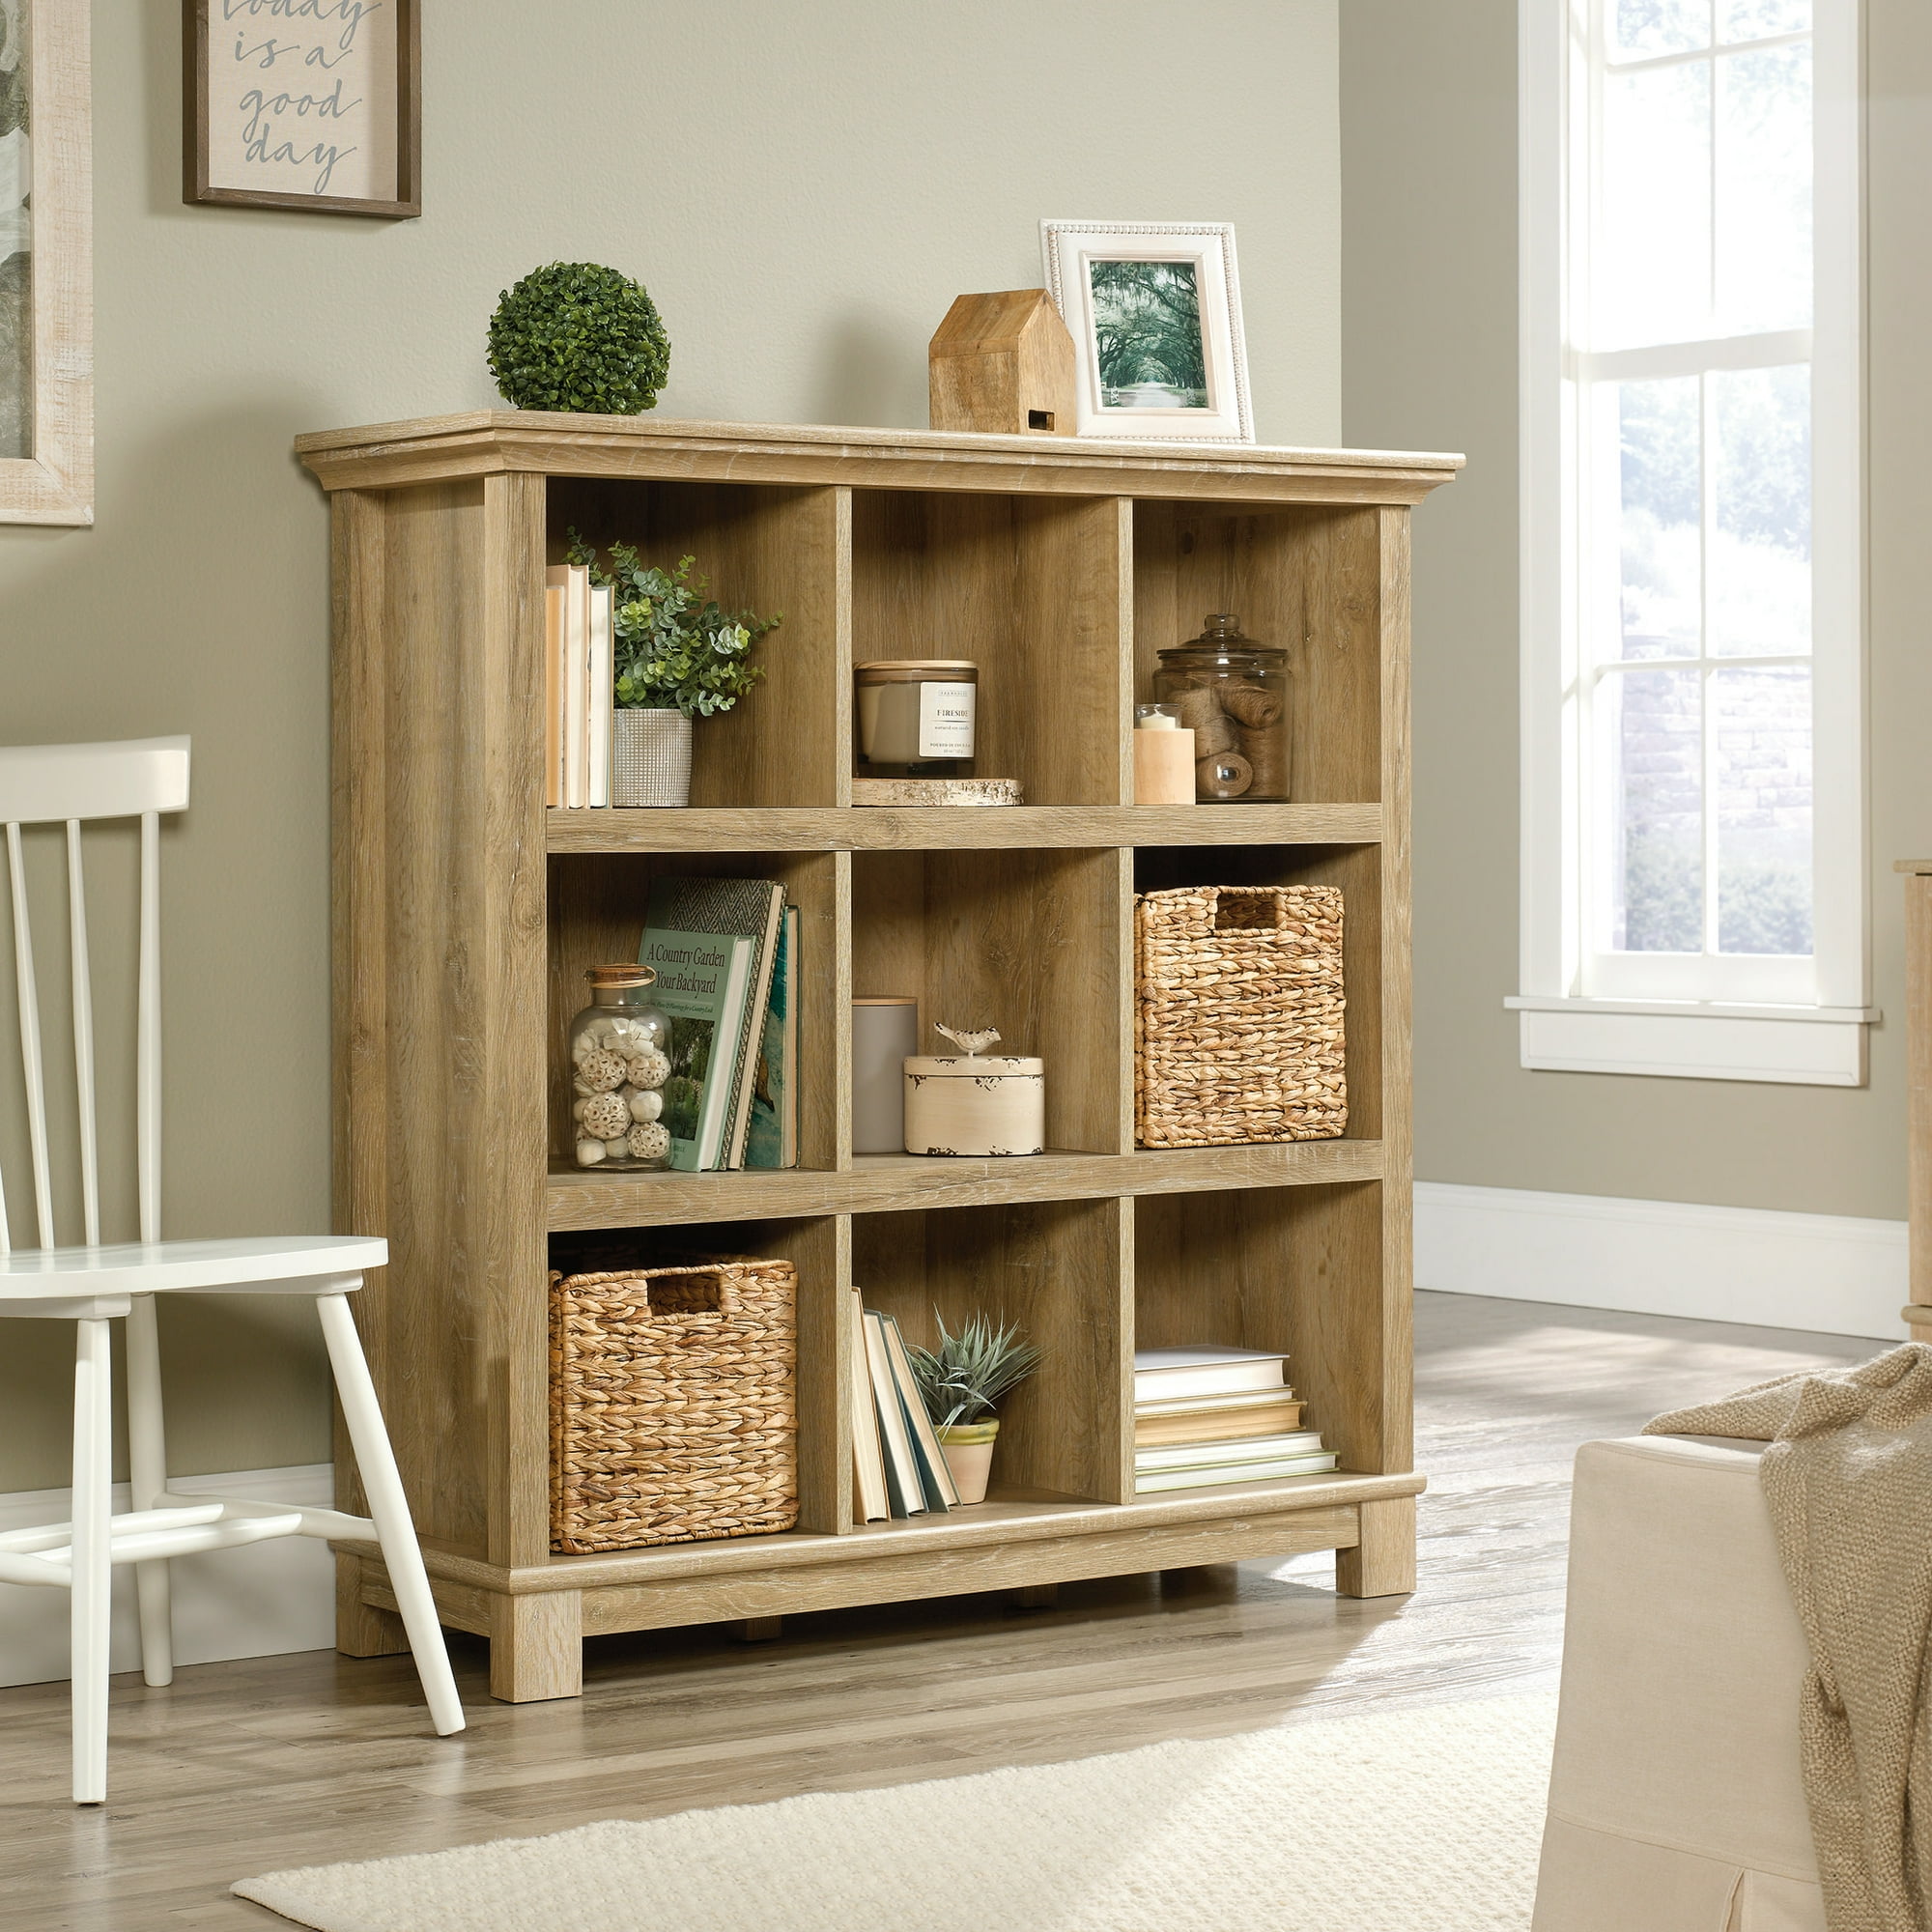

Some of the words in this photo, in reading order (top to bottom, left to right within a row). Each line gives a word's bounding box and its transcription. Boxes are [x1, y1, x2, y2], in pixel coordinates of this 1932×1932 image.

[235, 31, 300, 69] is
[304, 45, 354, 69] a
[239, 78, 362, 144] good
[245, 123, 357, 194] day
[646, 943, 654, 961] A
[656, 944, 694, 971] Country
[694, 946, 725, 967] Garden
[656, 971, 677, 989] Your
[676, 971, 718, 999] Backyard
